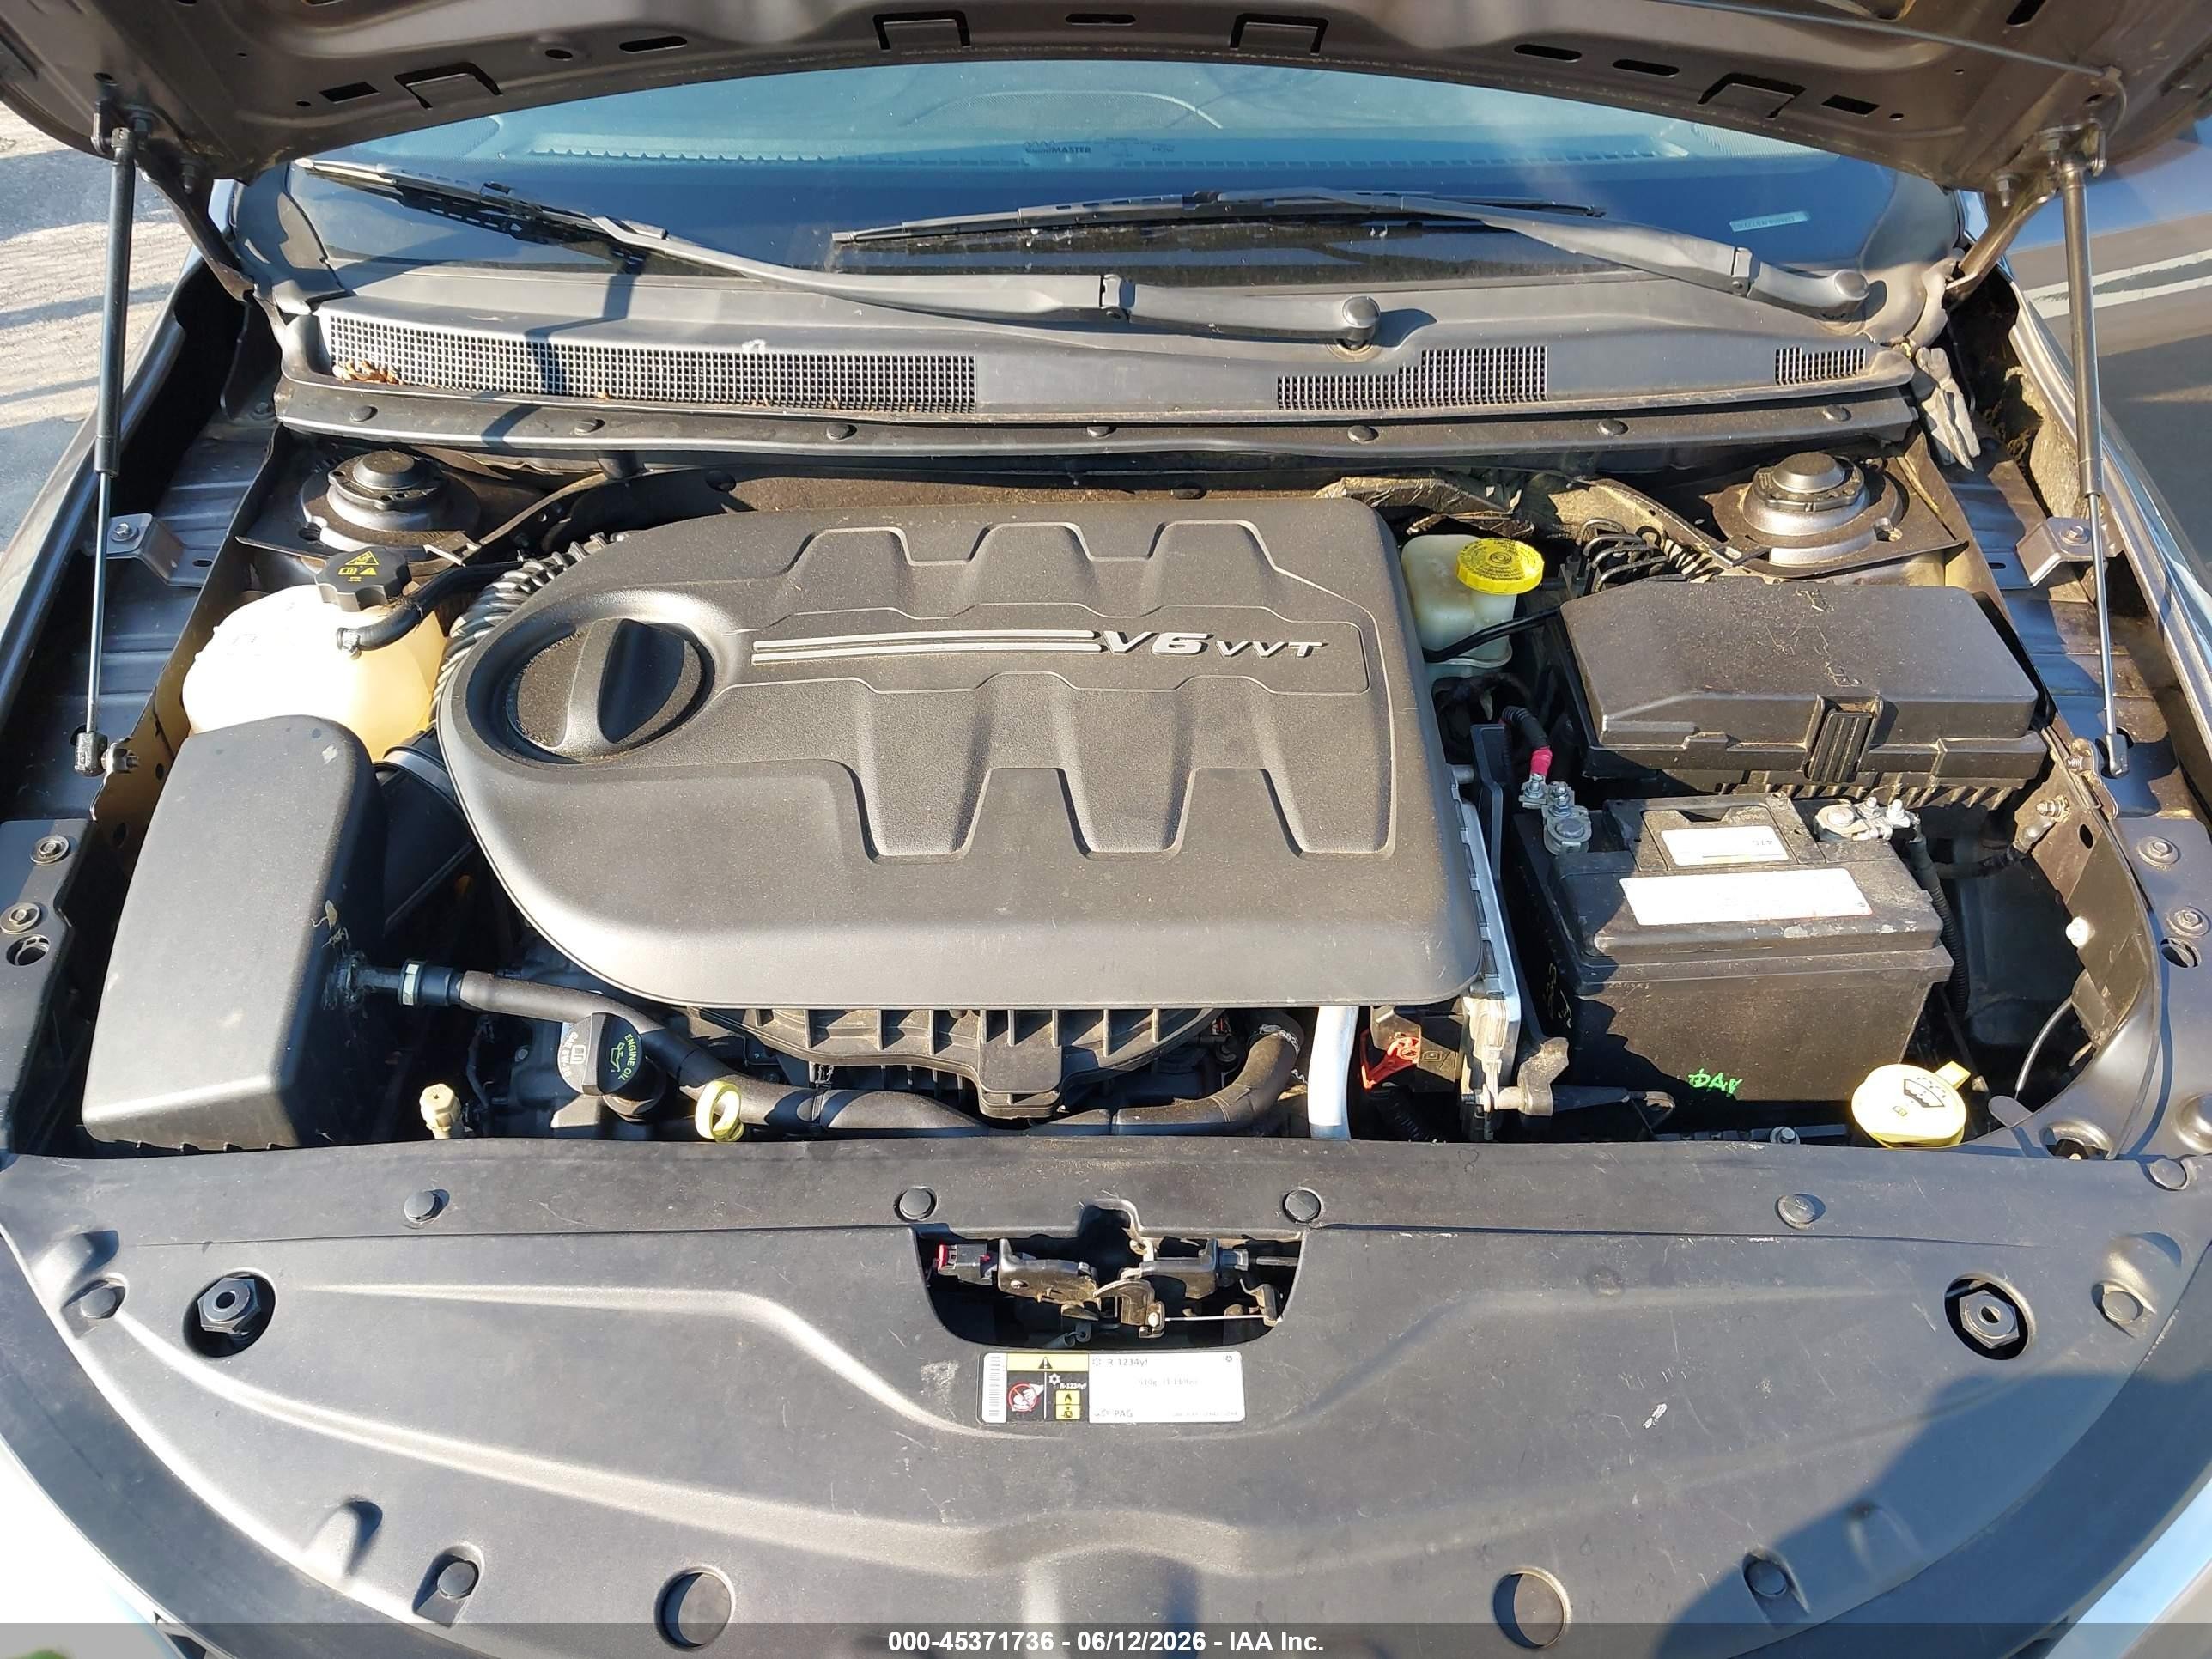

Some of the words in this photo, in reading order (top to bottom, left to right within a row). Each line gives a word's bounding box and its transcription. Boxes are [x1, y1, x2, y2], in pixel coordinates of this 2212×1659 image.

[1103, 631, 1209, 656] V6
[1216, 640, 1324, 659] VVT
[624, 1033, 637, 1066] ENGINE
[618, 1067, 633, 1081] OIL
[1114, 1409, 1133, 1418] PAG
